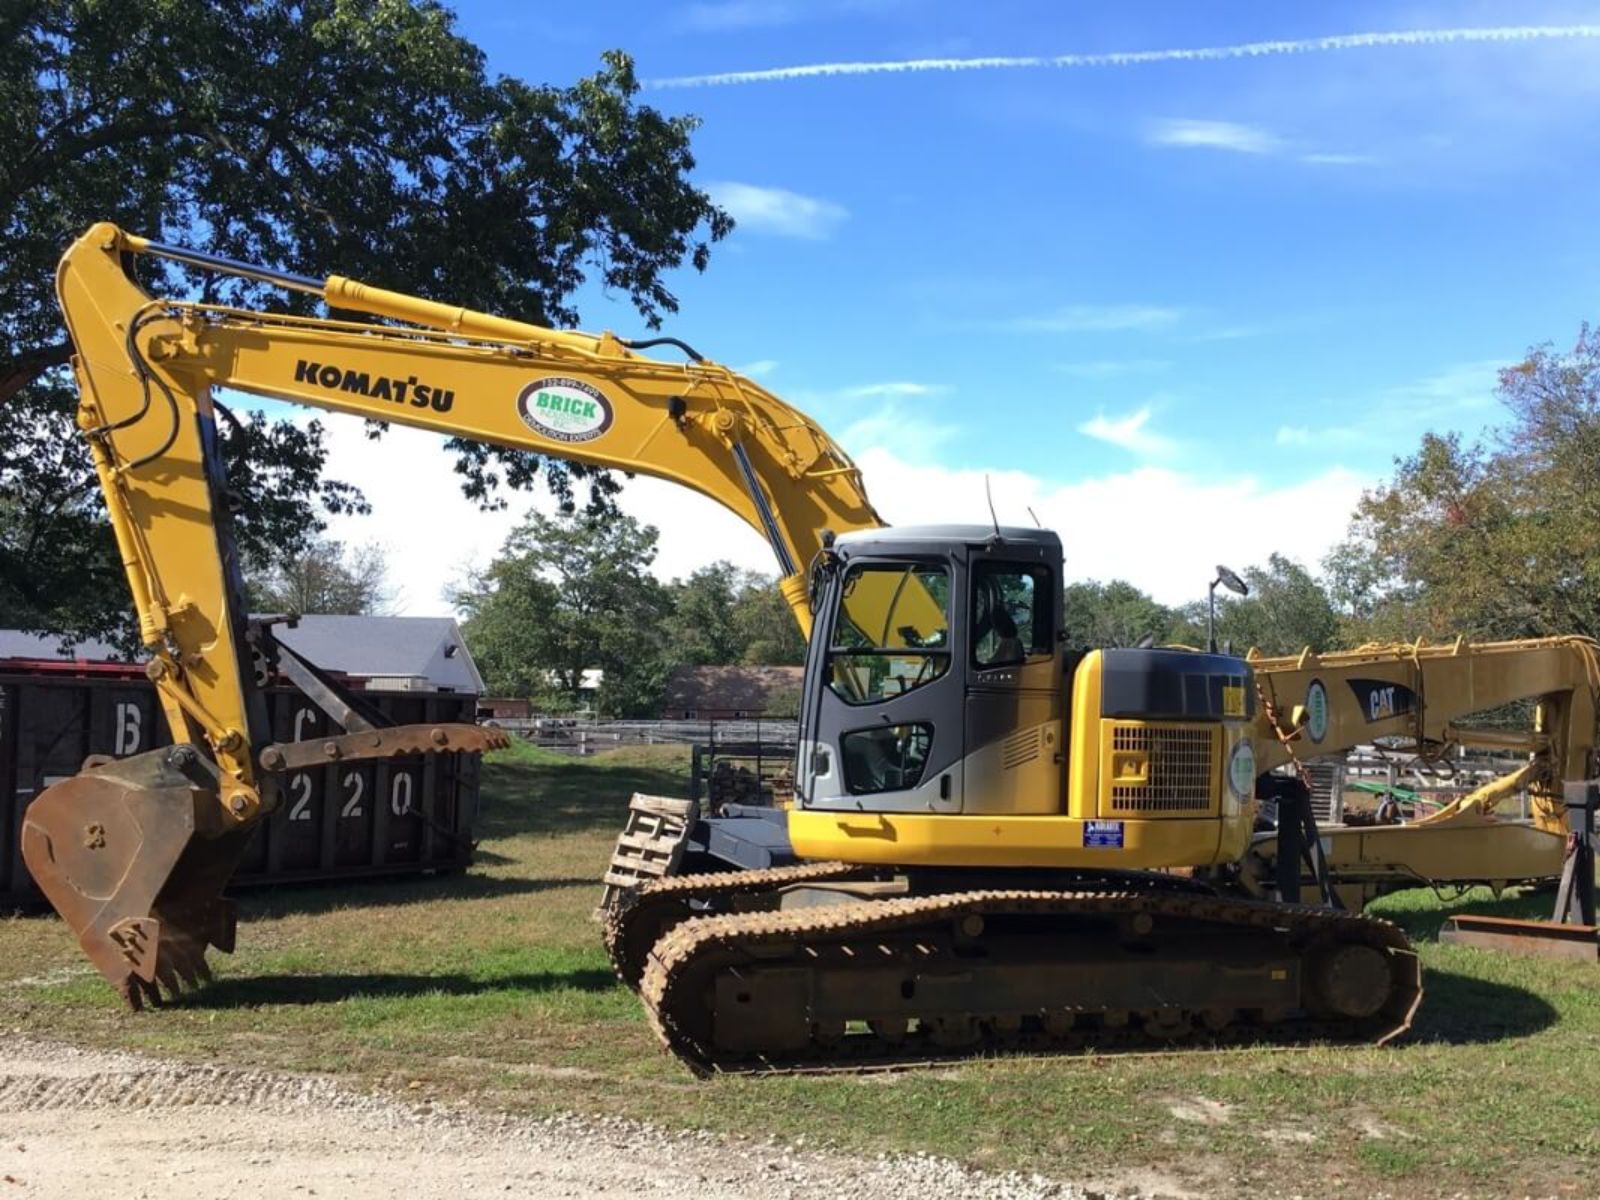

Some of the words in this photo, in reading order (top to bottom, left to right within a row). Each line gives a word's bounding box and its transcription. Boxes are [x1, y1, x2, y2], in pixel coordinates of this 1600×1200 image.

[294, 359, 455, 414] KOMATSU
[536, 392, 598, 419] BRICK
[1370, 687, 1395, 721] CAT
